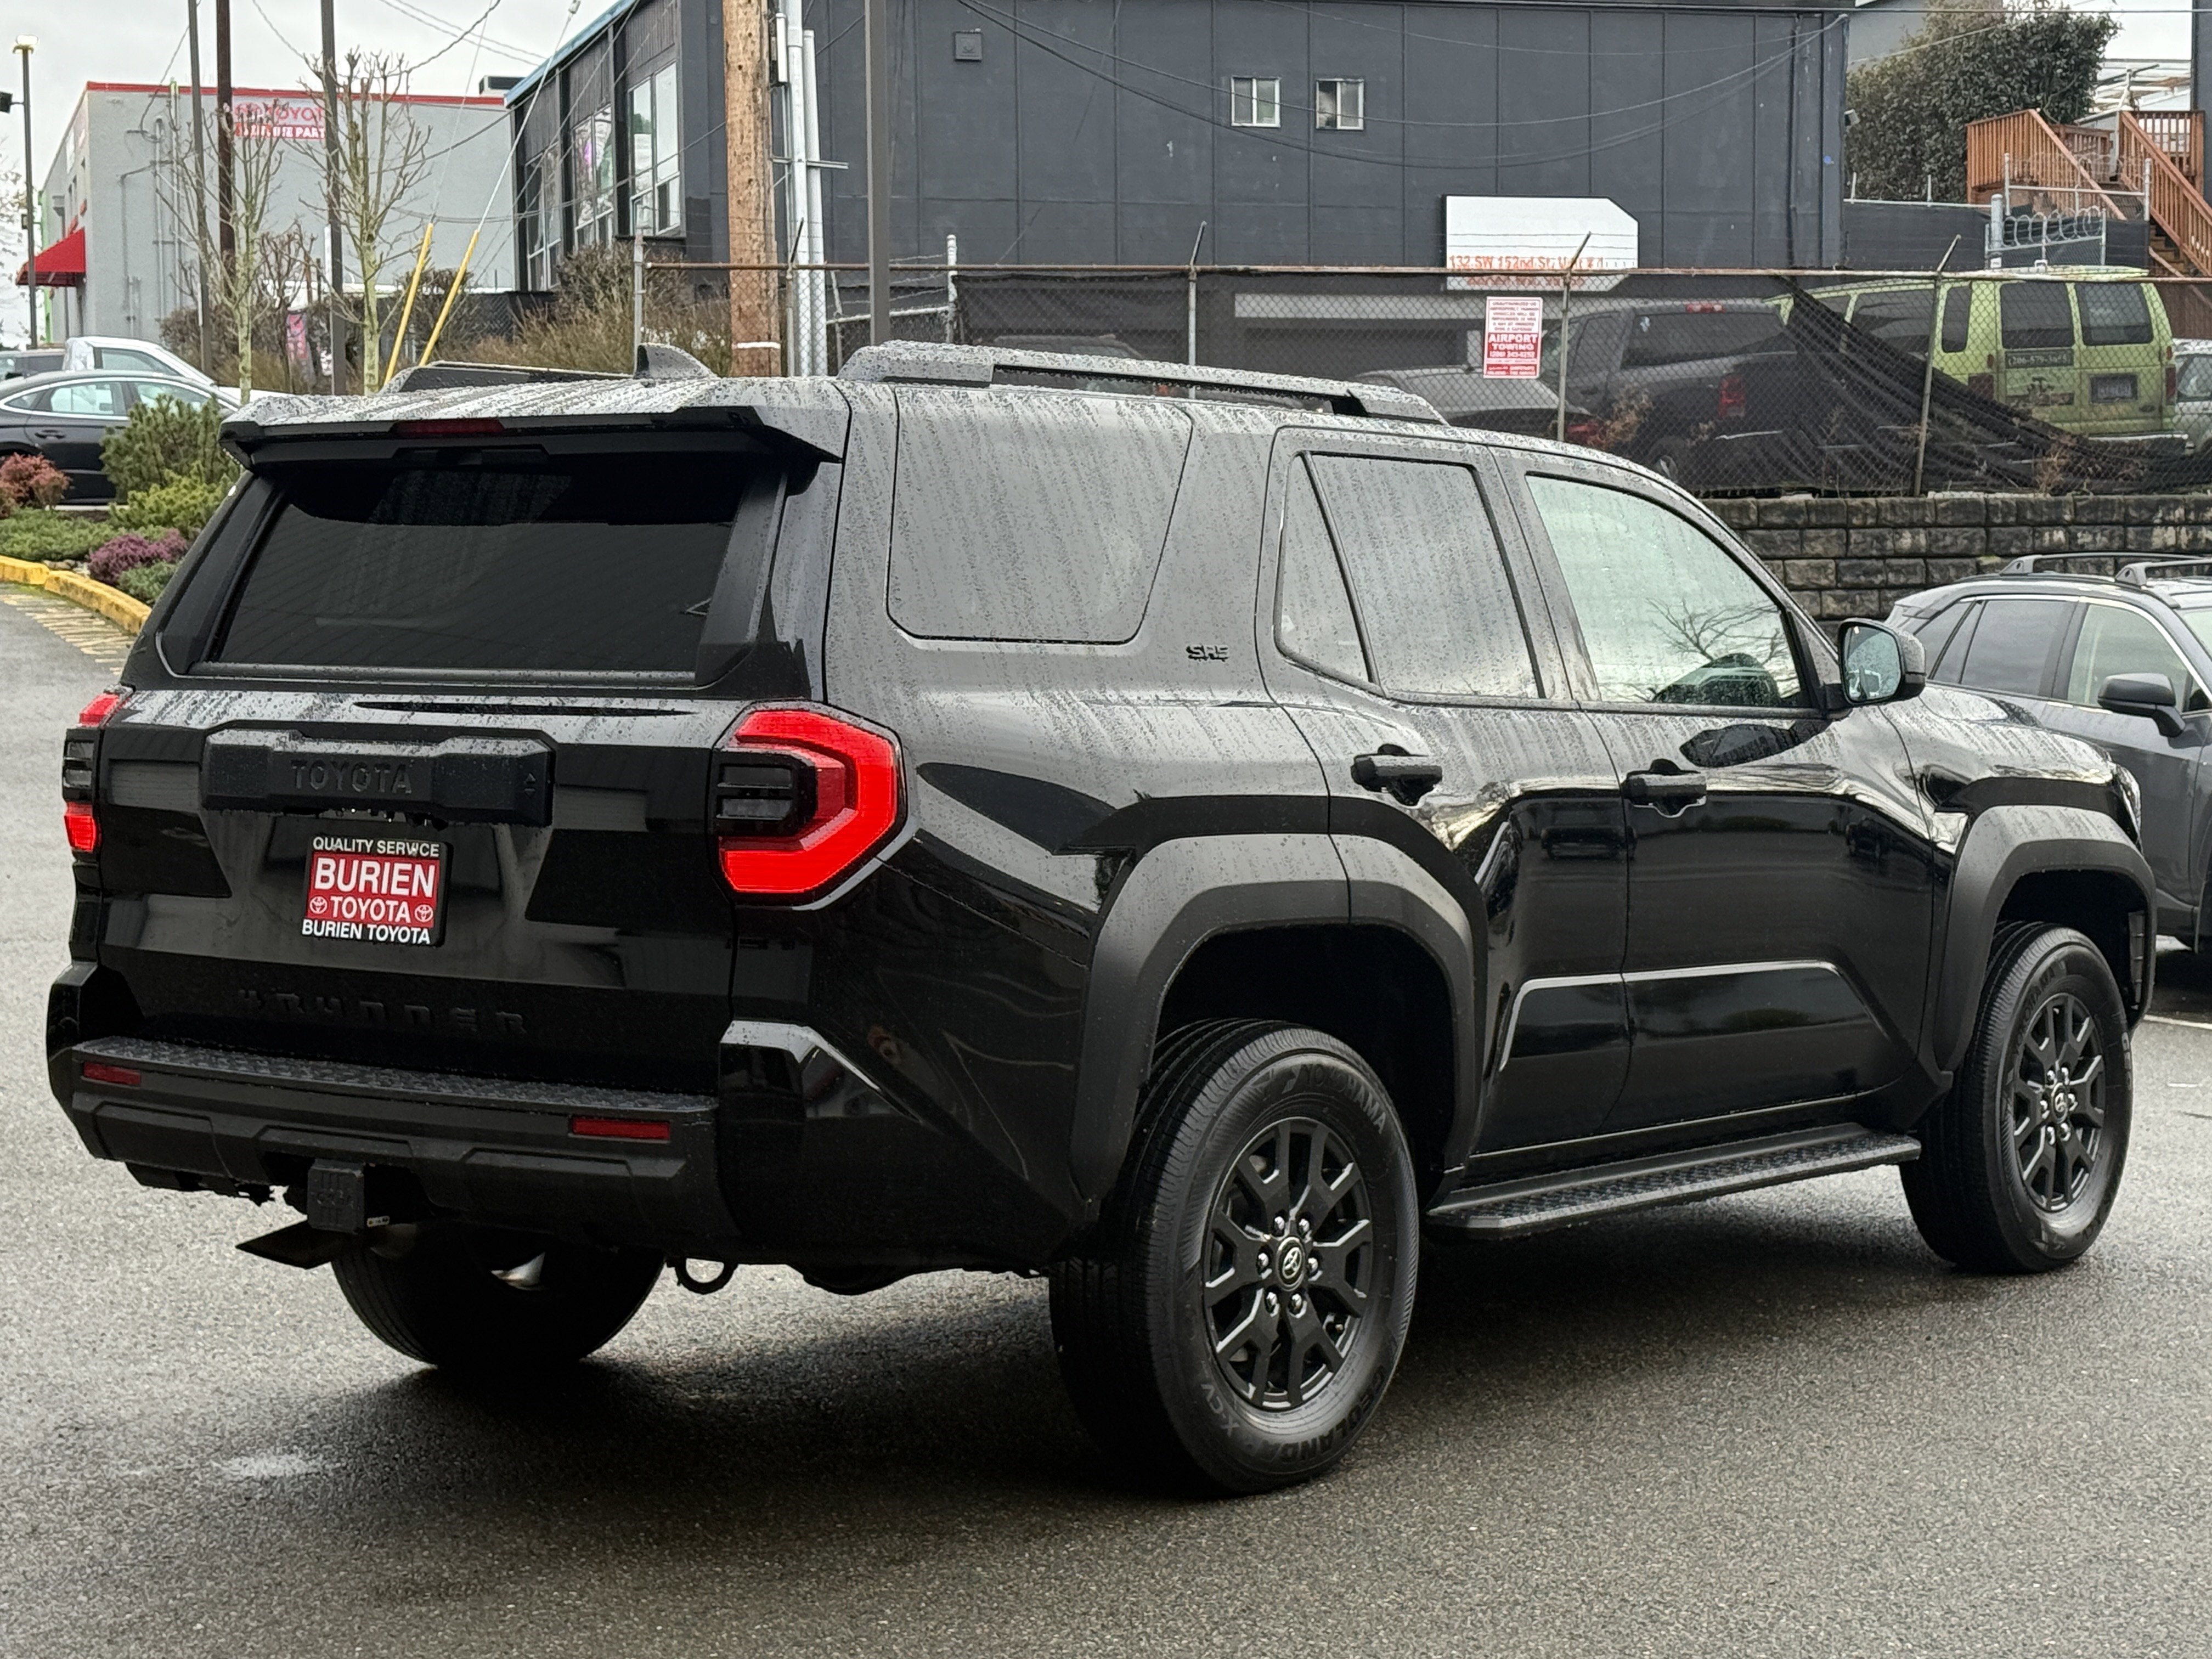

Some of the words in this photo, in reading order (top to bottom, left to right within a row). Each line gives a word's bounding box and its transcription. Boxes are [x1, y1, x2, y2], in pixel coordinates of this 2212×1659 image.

[295, 126, 325, 138] PART
[1488, 334, 1538, 343] AIRPORT
[291, 759, 411, 793] TOYOTA
[313, 837, 373, 853] QUALITY
[377, 840, 439, 857] SERVICE
[314, 857, 435, 898] BURIEN
[330, 896, 411, 923] TOYOTA
[302, 919, 362, 939] BURIEN
[367, 924, 430, 944] TOYOTA
